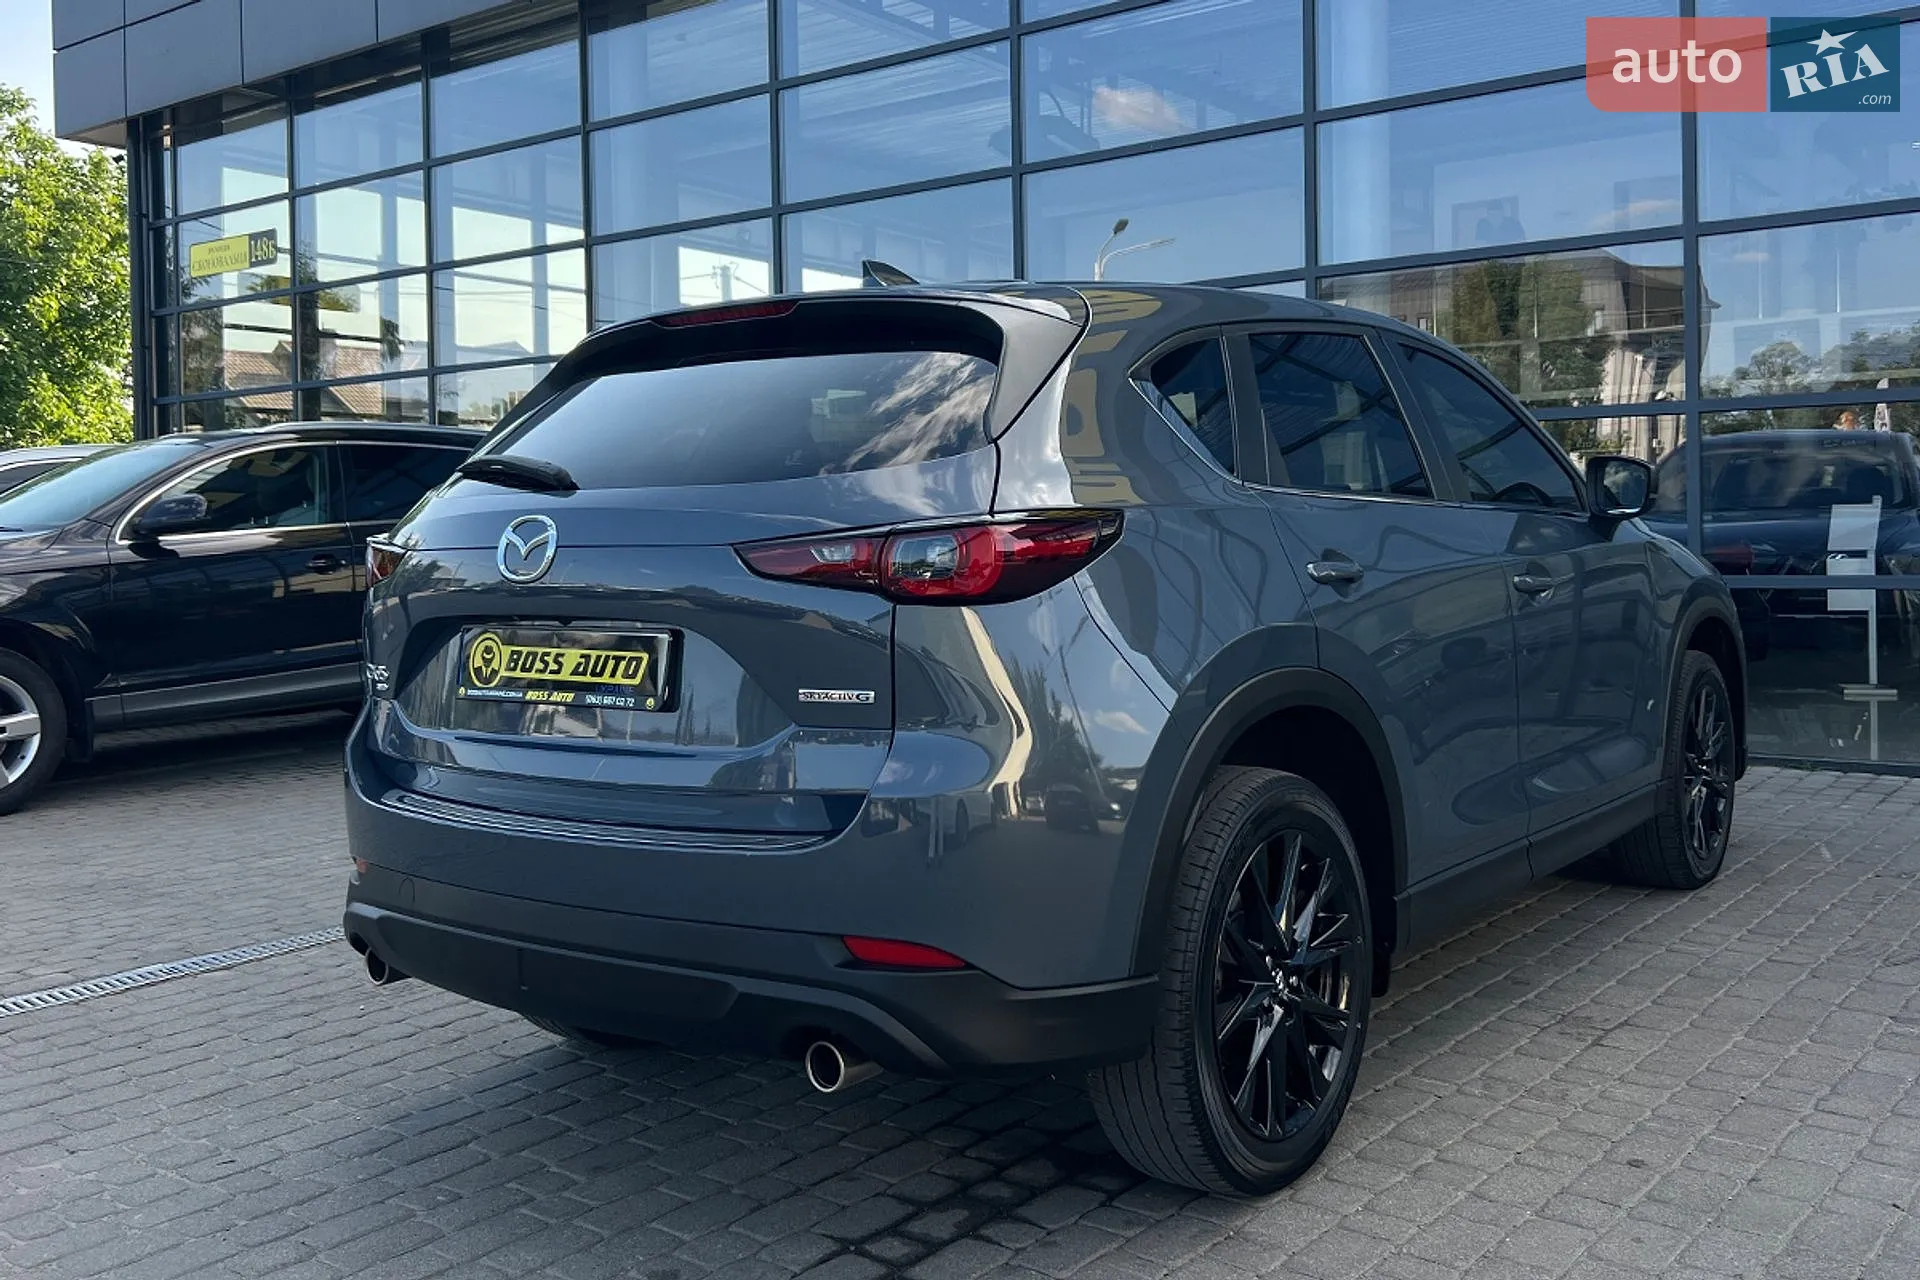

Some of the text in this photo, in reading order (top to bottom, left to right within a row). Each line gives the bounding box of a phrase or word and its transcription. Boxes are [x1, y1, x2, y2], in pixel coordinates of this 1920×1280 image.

[505, 649, 644, 680] BOSS AUTO
[525, 690, 549, 701] BOSS
[550, 692, 576, 703] AUTO
